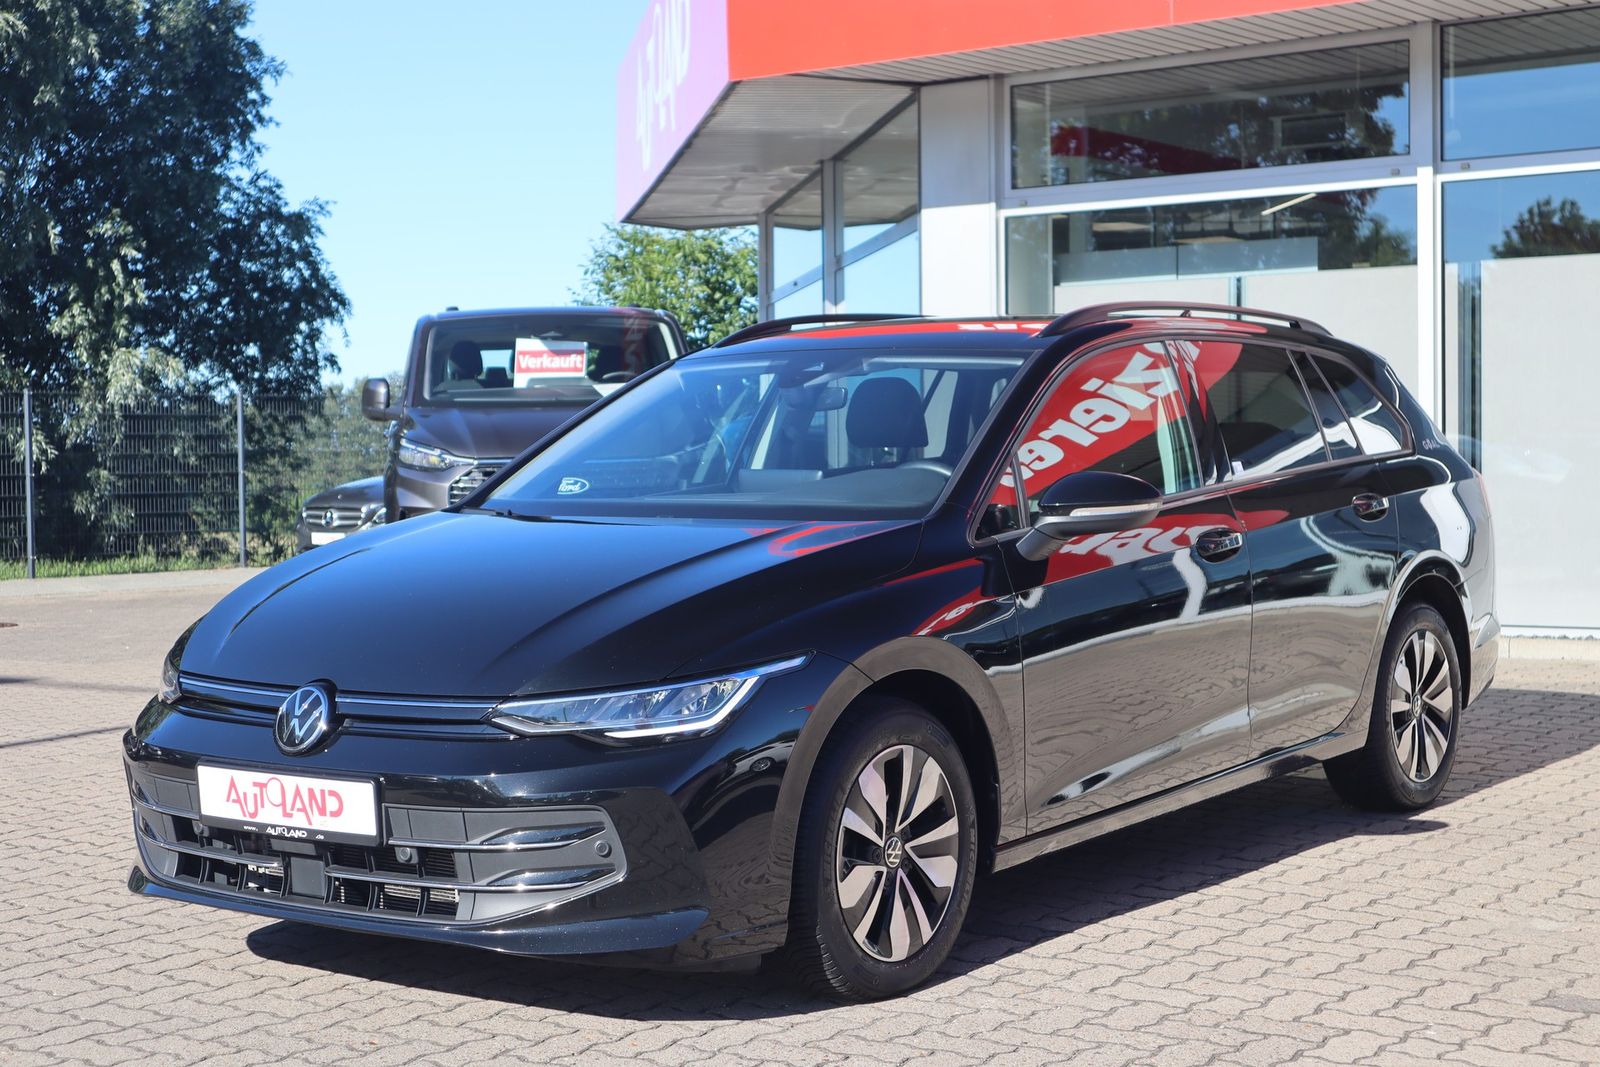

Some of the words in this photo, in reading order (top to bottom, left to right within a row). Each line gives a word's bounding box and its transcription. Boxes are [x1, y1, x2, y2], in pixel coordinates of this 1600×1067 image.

[518, 353, 583, 369] Verkauft
[226, 775, 344, 826] AUTOLAND
[265, 825, 308, 839] AUTOLAND
